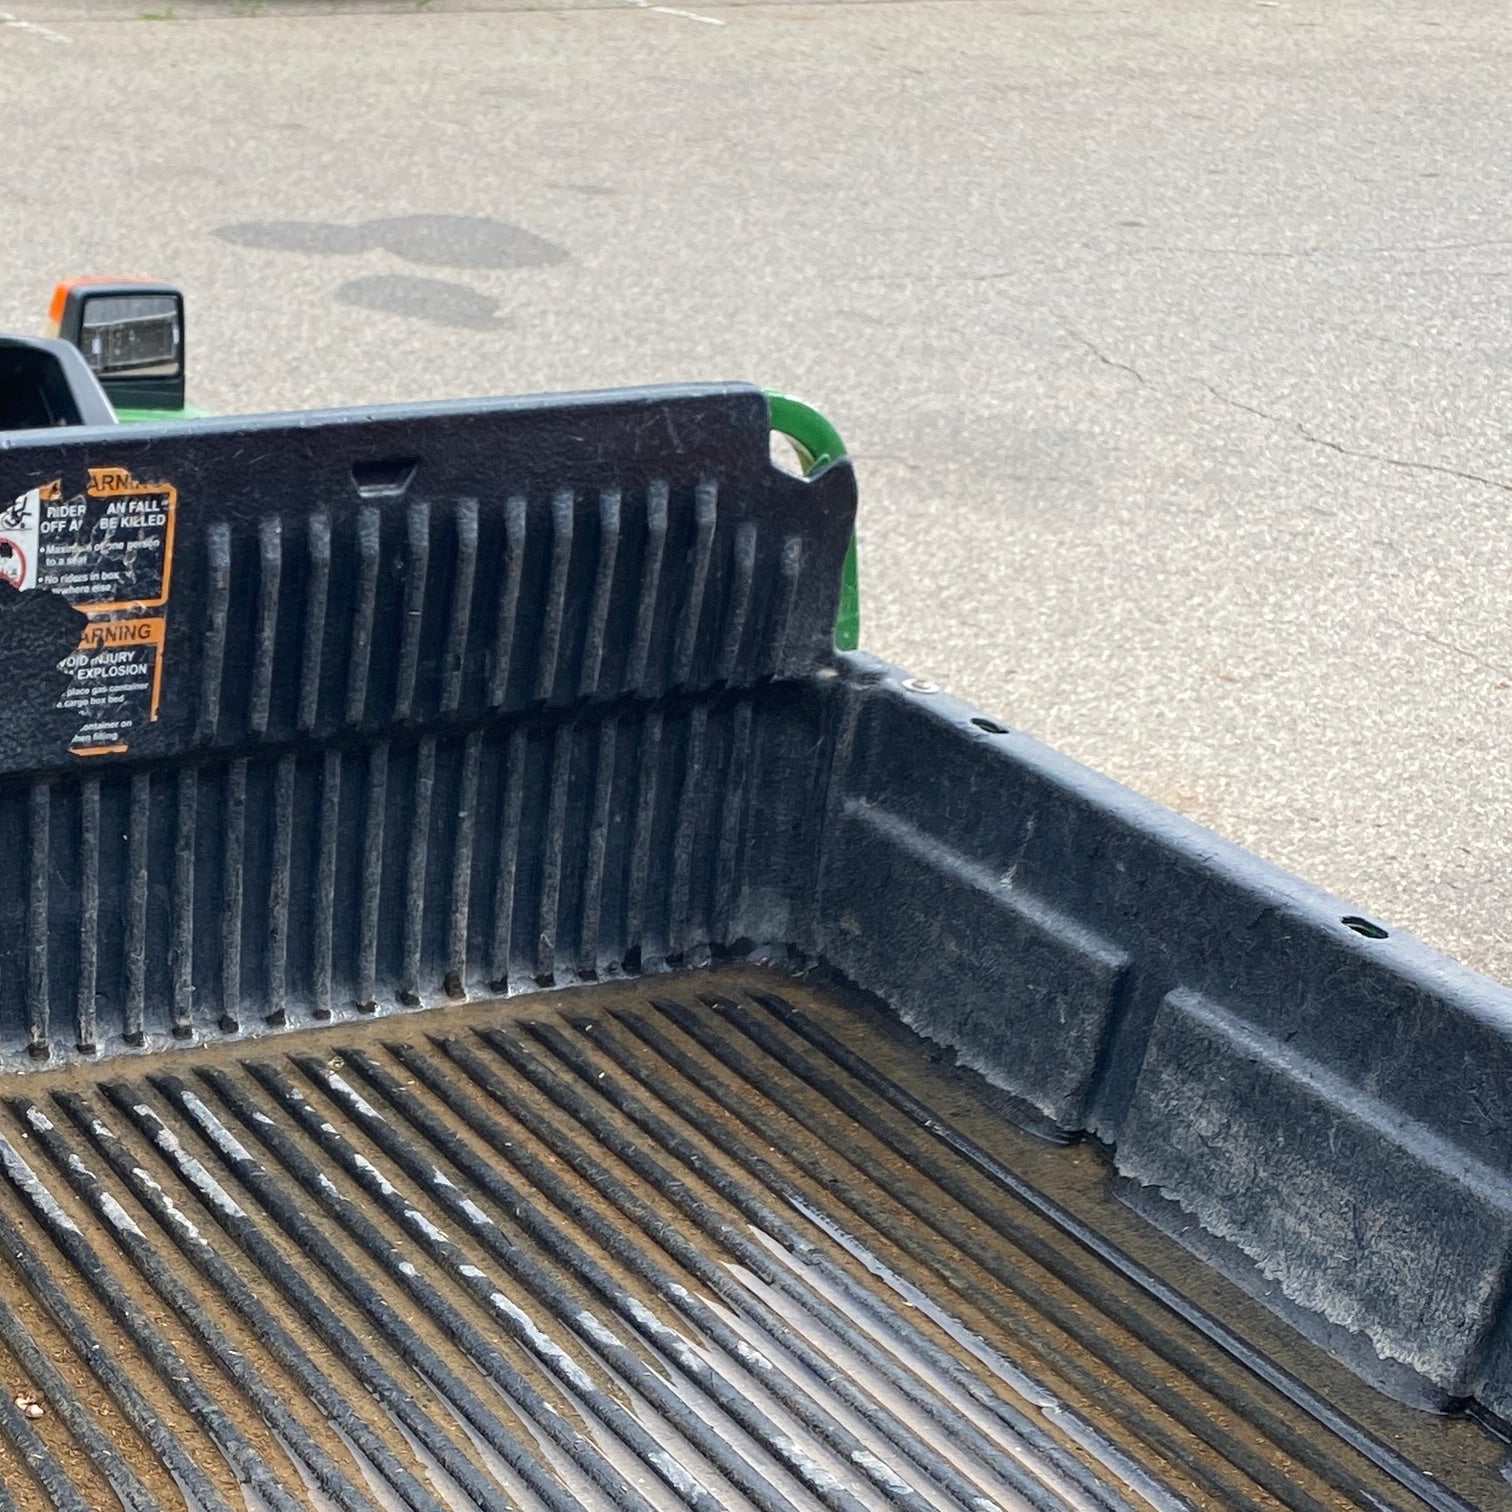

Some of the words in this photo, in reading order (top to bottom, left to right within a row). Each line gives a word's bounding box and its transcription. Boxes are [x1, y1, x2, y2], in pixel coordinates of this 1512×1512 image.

[47, 504, 87, 518] RIDER
[128, 499, 160, 513] FALL
[40, 520, 66, 534] OFF
[99, 516, 119, 530] BE
[120, 513, 167, 528] KILLED
[44, 575, 59, 585] No
[89, 573, 100, 582] in
[101, 571, 120, 581] box
[81, 623, 152, 644] ARNING
[77, 663, 149, 680] EXPLOSION
[120, 720, 133, 728] on
